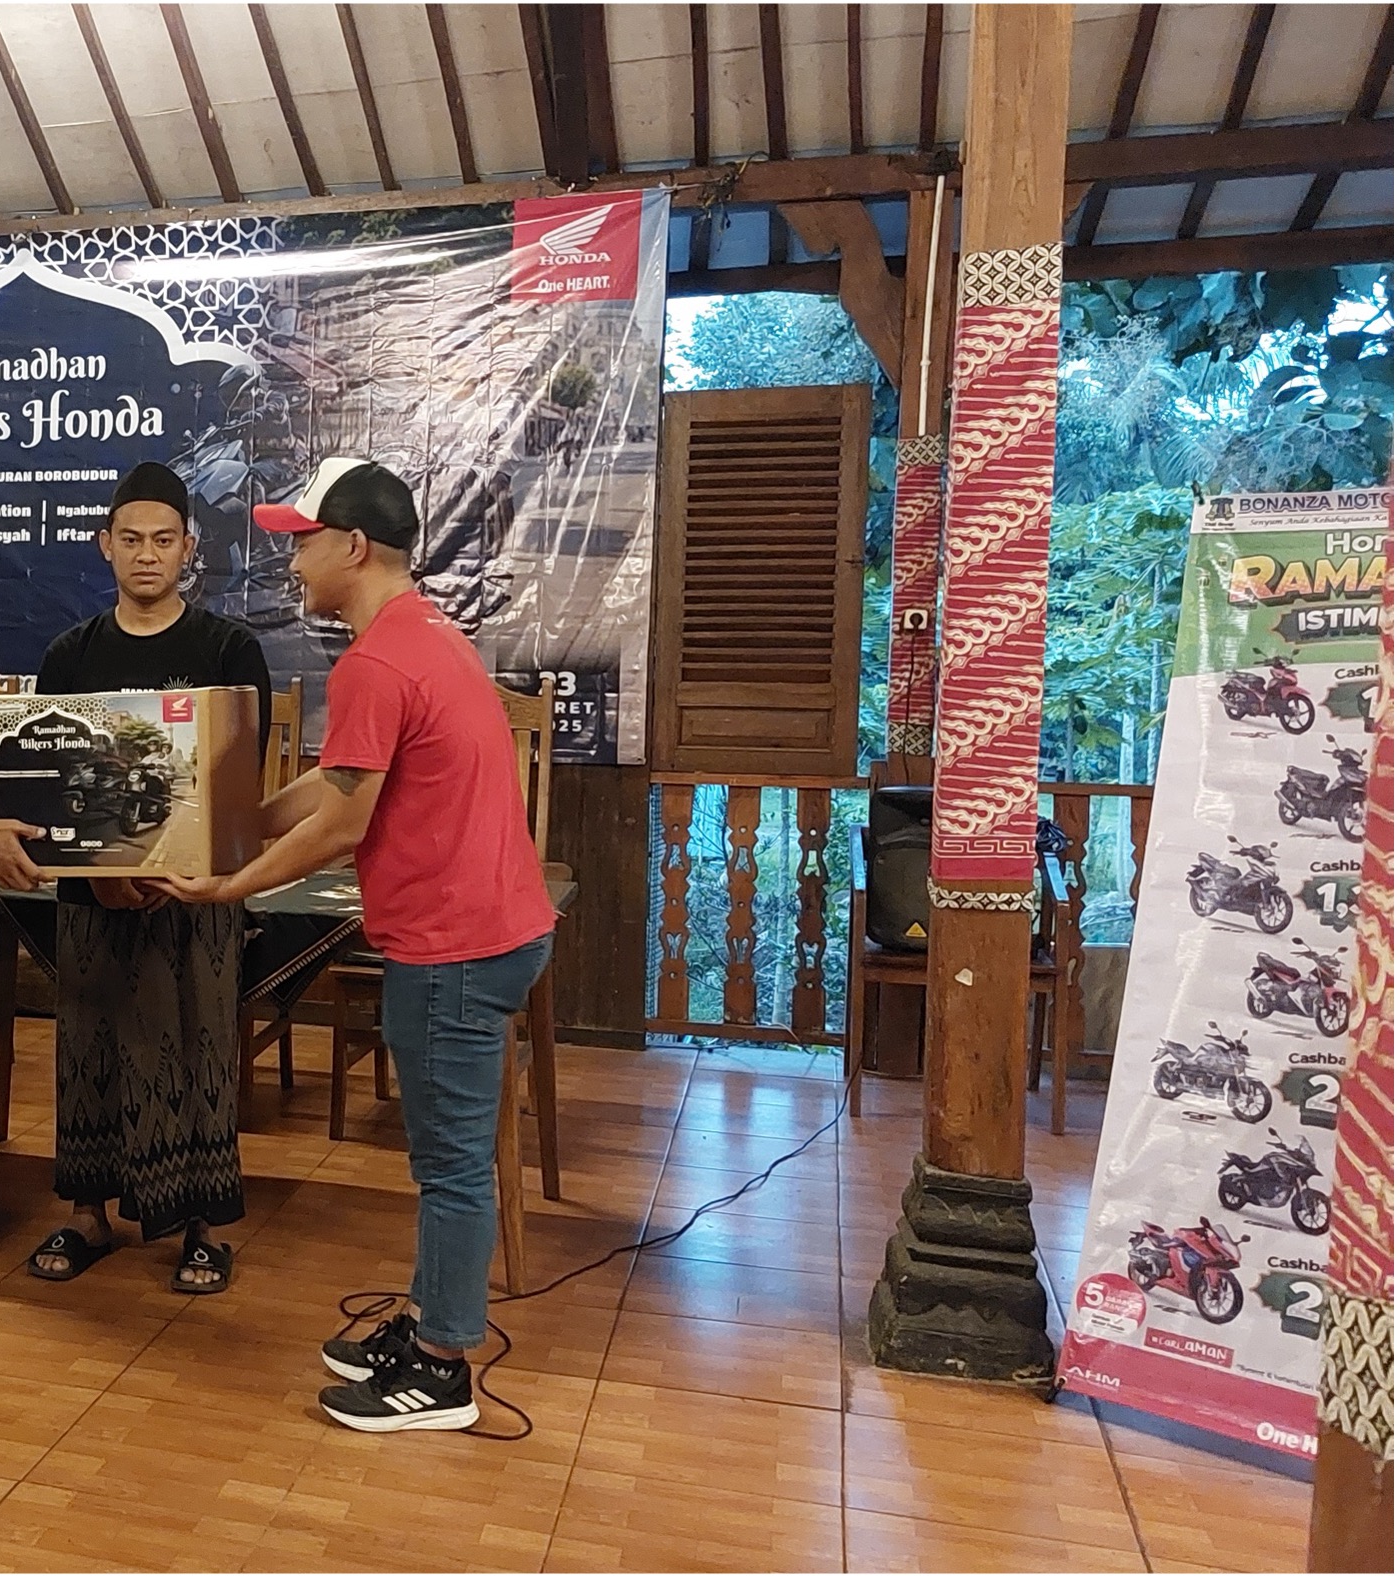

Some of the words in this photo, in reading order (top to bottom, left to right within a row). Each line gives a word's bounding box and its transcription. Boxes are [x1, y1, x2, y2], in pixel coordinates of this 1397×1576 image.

[539, 252, 611, 266] HONDA
[538, 278, 564, 293] One
[566, 275, 611, 291] HEART.
[20, 389, 165, 449] Honda
[35, 469, 119, 482] BOROBUDUR
[1240, 495, 1332, 511] BONANZA
[1337, 492, 1392, 508] MOTO
[57, 504, 111, 518] Ngabubu
[57, 528, 95, 542] Iftar
[1229, 554, 1388, 603] RAMA
[1297, 606, 1379, 631] ISTIM
[1334, 664, 1380, 680] Cash
[554, 701, 595, 715] RET
[32, 724, 76, 736] Ramadhan
[18, 738, 52, 752] Bikers
[53, 736, 91, 751] Honda
[1309, 859, 1361, 873] Cashb
[1288, 1052, 1347, 1066] Cashba
[1267, 1256, 1329, 1273] Cashba
[1084, 1281, 1105, 1307] 5
[1065, 1366, 1120, 1387] AHM
[1257, 1421, 1300, 1449] One
